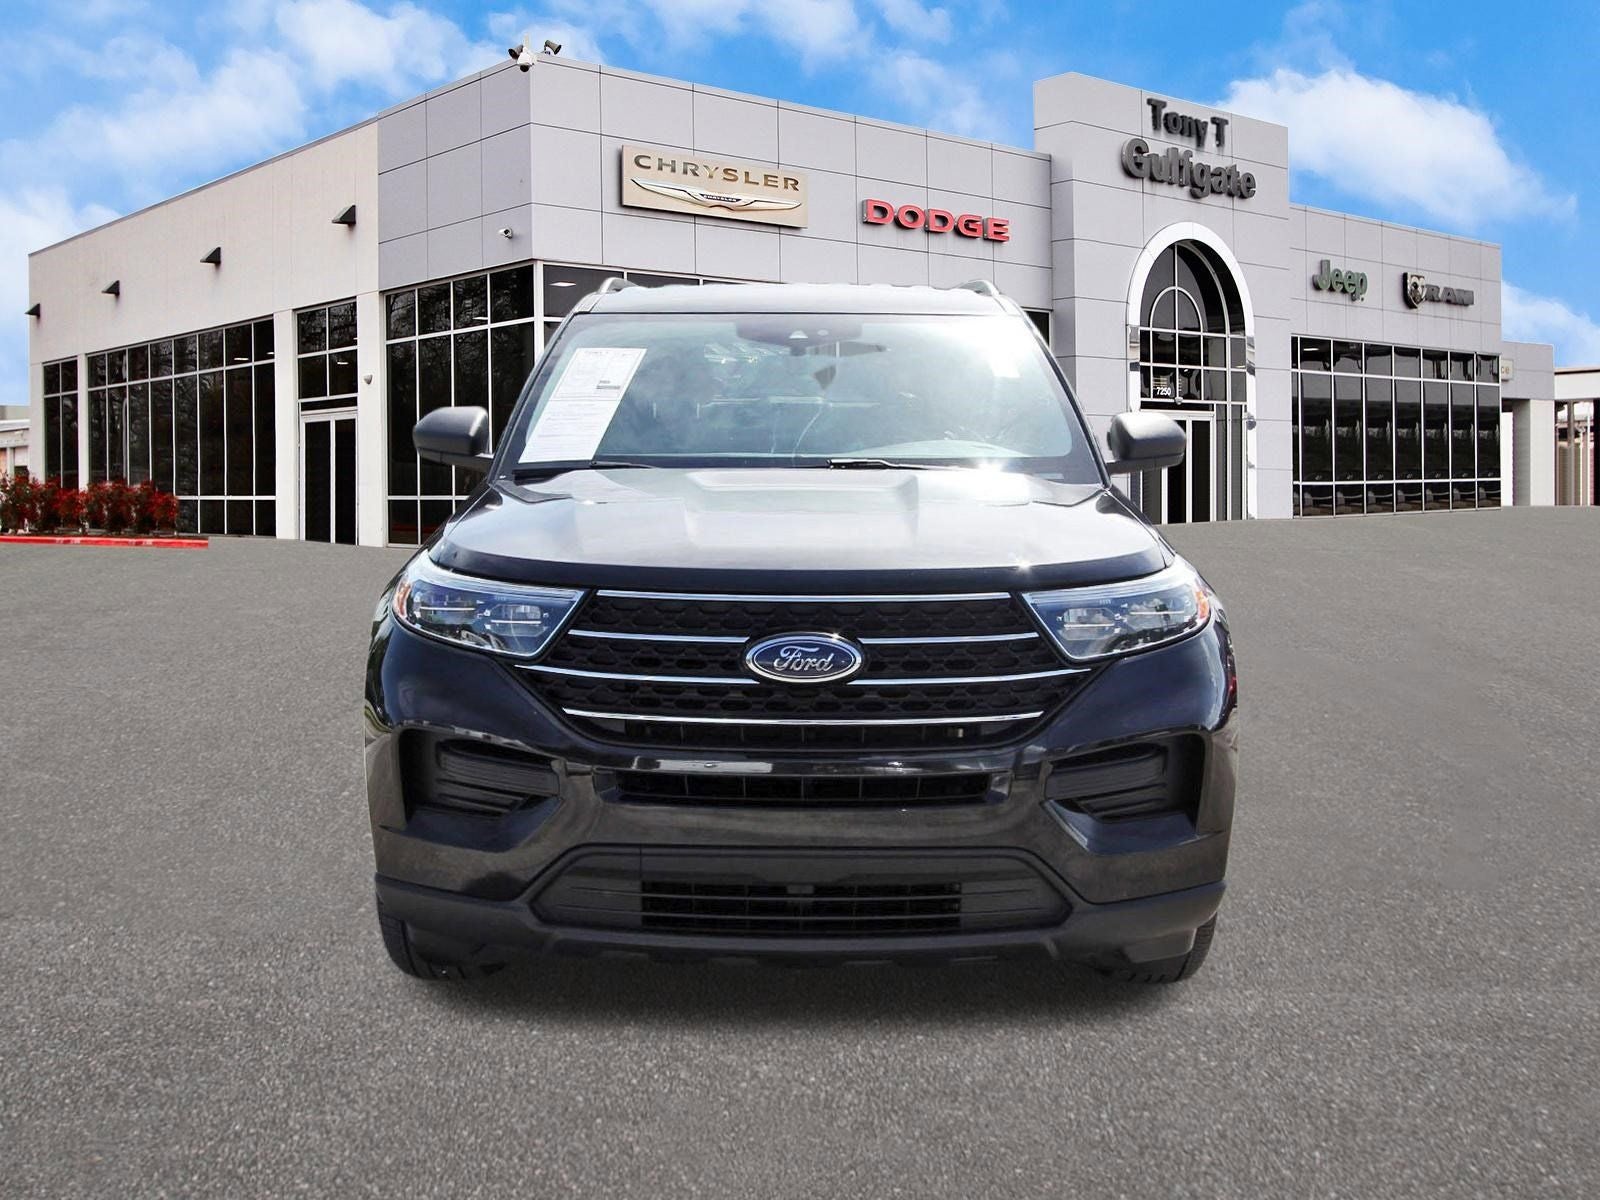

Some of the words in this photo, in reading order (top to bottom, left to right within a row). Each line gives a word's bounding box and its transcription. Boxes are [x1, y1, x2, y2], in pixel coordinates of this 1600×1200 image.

[1146, 98, 1208, 147] Tony
[1211, 116, 1229, 147] T
[634, 154, 800, 192] CHRYSLER
[1121, 138, 1256, 199] Gulfgate
[863, 198, 1010, 242] DODGE
[1312, 259, 1368, 301] Jeep
[1425, 284, 1475, 307] RAM
[1156, 386, 1172, 396] 7250
[773, 645, 834, 672] Ford
